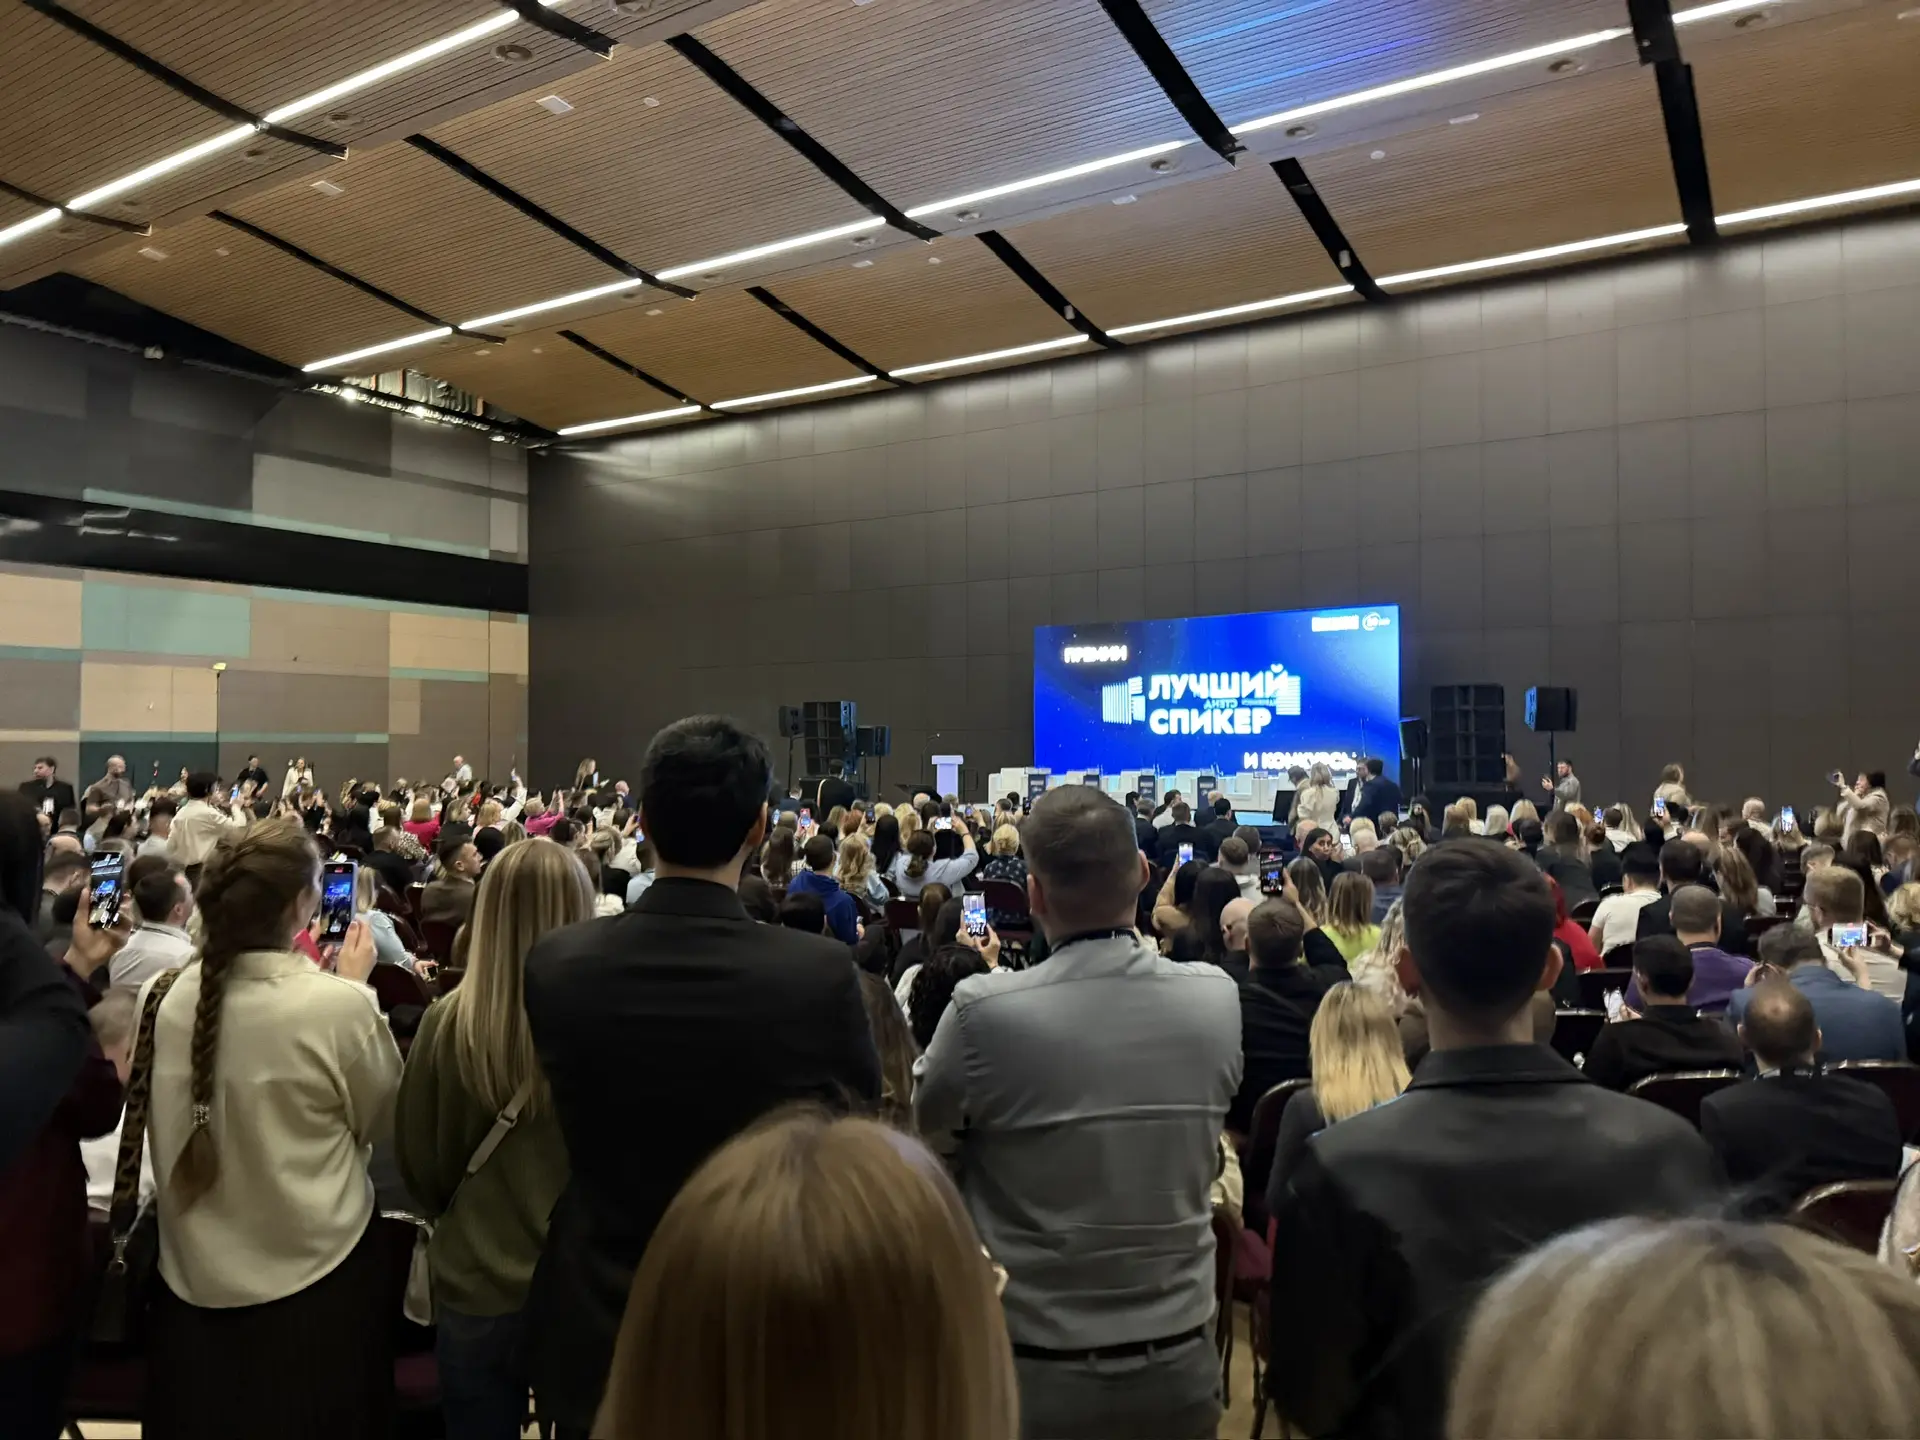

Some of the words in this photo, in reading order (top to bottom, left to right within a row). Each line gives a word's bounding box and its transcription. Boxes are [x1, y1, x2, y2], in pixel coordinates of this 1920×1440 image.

[1148, 663, 1288, 700] ЛУЧШИЙ
[1149, 707, 1272, 735] СПИКЕР
[1243, 752, 1258, 769] И
